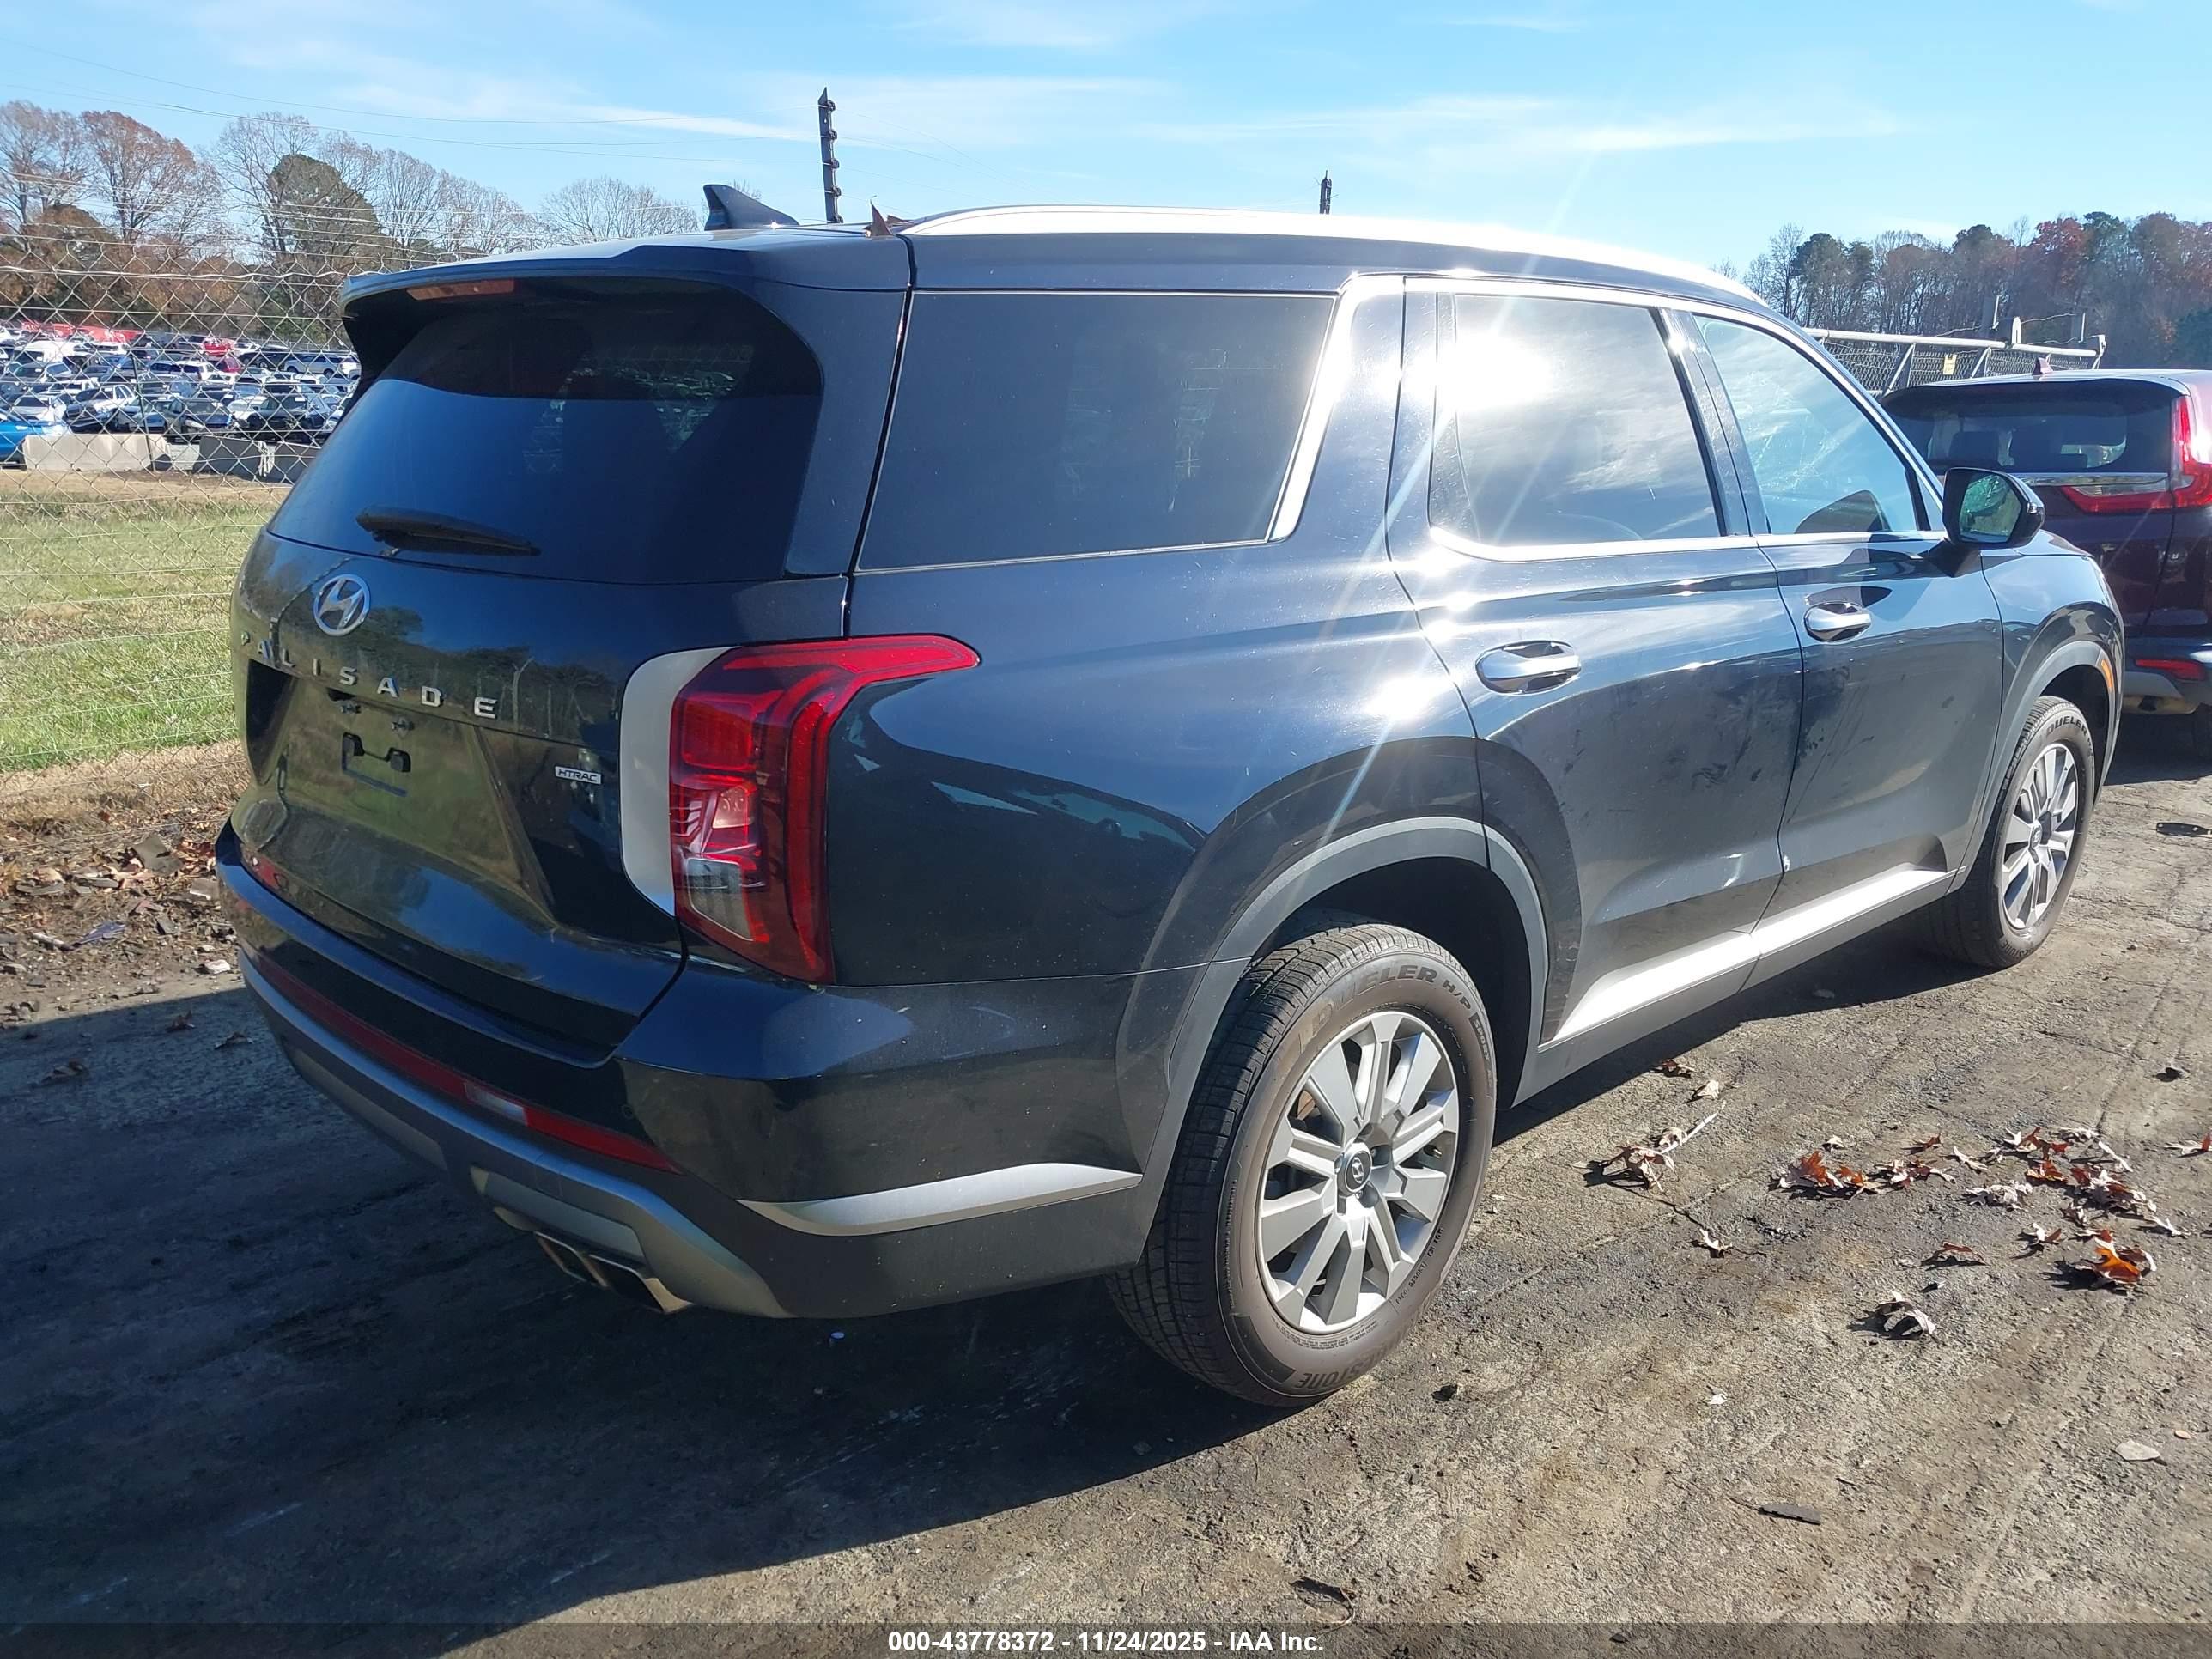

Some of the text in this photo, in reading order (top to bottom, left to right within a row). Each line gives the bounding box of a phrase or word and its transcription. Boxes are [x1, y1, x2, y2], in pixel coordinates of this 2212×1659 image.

[240, 631, 498, 720] PALISADE
[558, 769, 598, 782] HTRAC
[1442, 979, 1472, 1012] H/P
